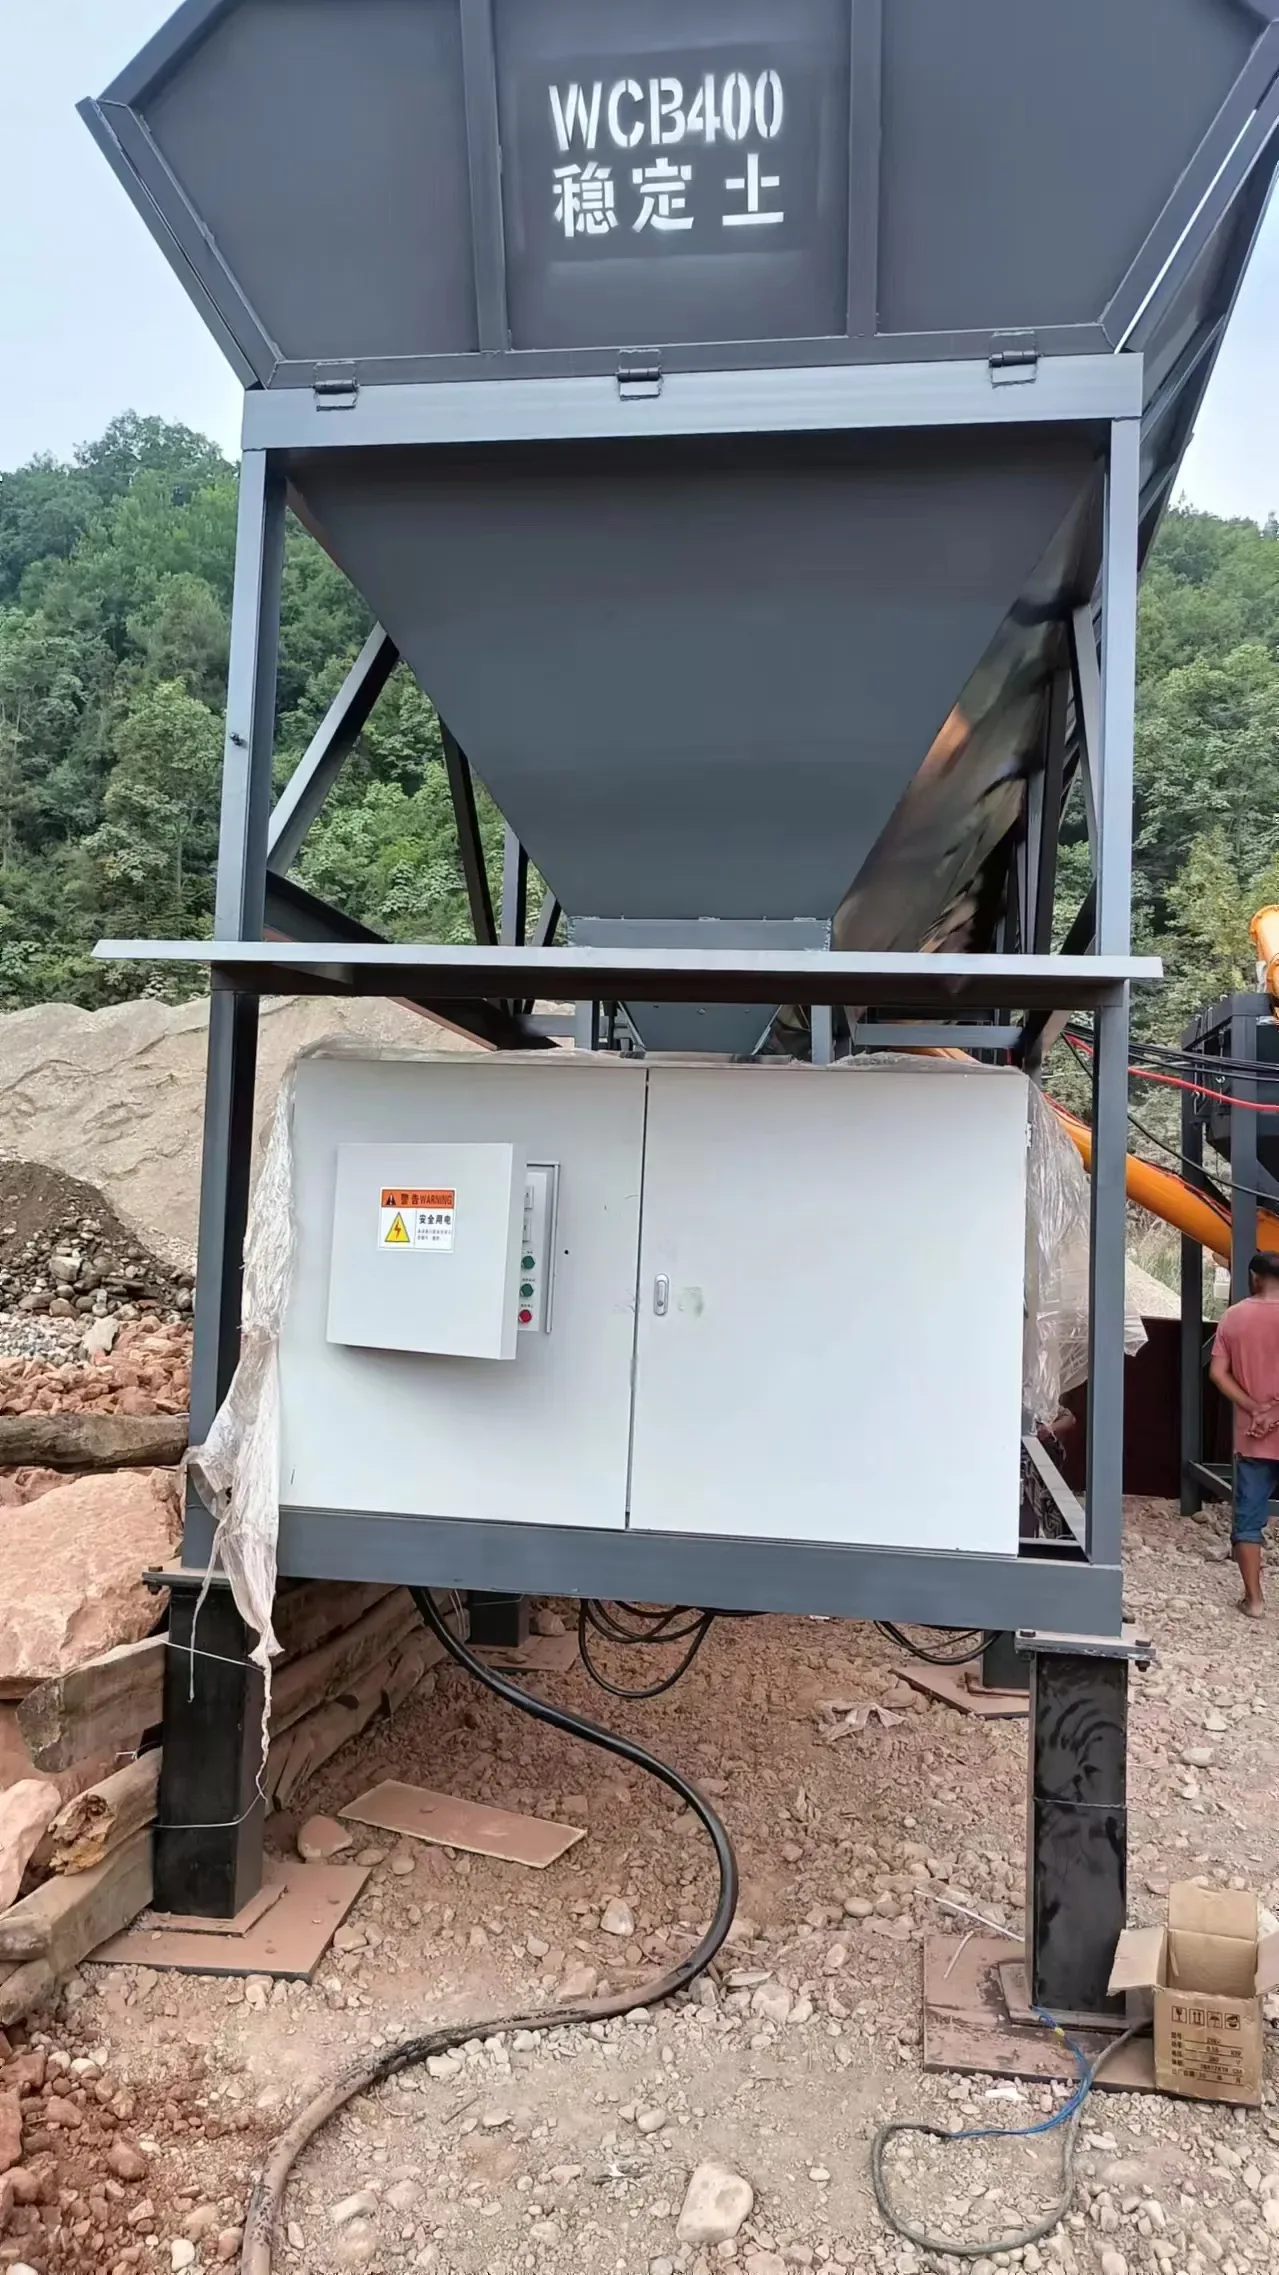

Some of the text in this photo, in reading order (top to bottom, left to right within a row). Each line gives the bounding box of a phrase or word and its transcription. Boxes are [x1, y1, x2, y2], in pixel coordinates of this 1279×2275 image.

[549, 69, 784, 150] WCB400
[553, 153, 784, 237] 稳定土
[401, 1193, 452, 1205] 警告 WARNING
[419, 1214, 451, 1225] 安全用电
